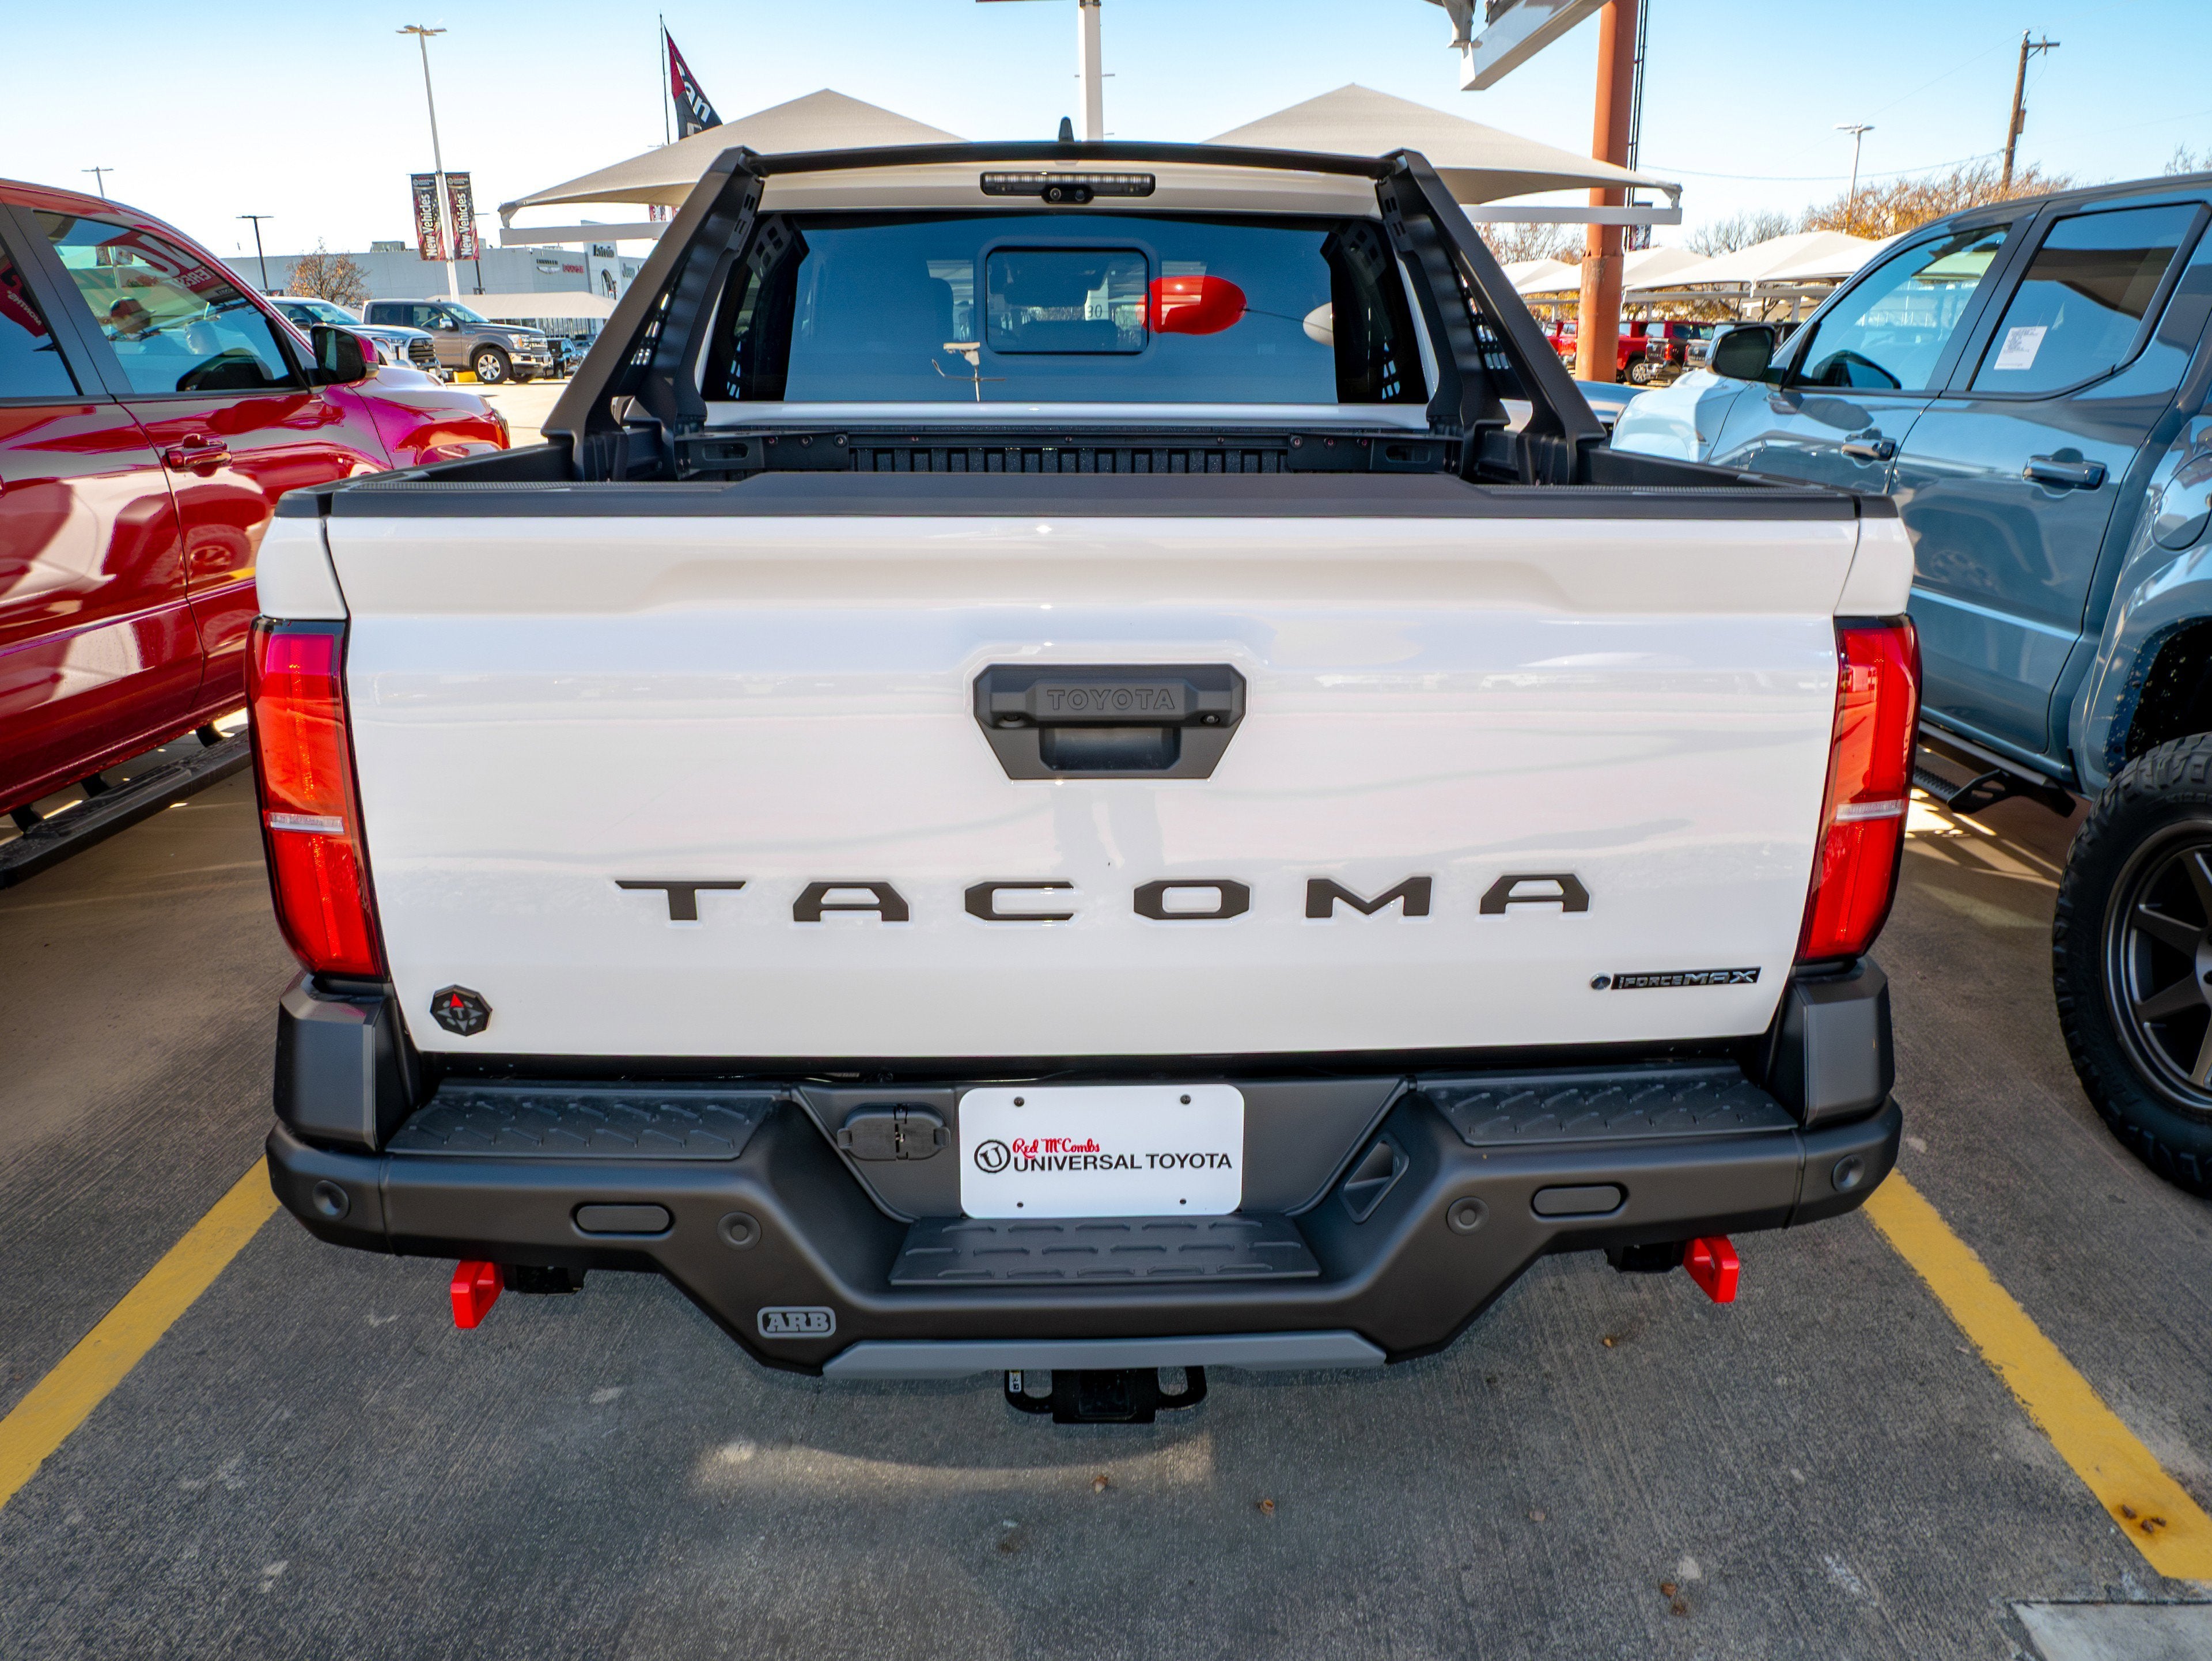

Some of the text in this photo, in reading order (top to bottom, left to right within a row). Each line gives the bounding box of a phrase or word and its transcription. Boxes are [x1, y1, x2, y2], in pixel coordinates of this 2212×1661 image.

[419, 194, 434, 234] Vehicles
[456, 192, 471, 234] Vehicles
[426, 235, 438, 257] New
[461, 234, 472, 256] New
[1087, 304, 1103, 318] 30
[1047, 688, 1175, 710] TOYOTA
[615, 873, 1590, 922] TACOMA
[1012, 1137, 1100, 1159] Red McCombs
[1014, 1153, 1233, 1172] UNIVERSAL TOYOTA
[767, 1312, 829, 1332] ARB
